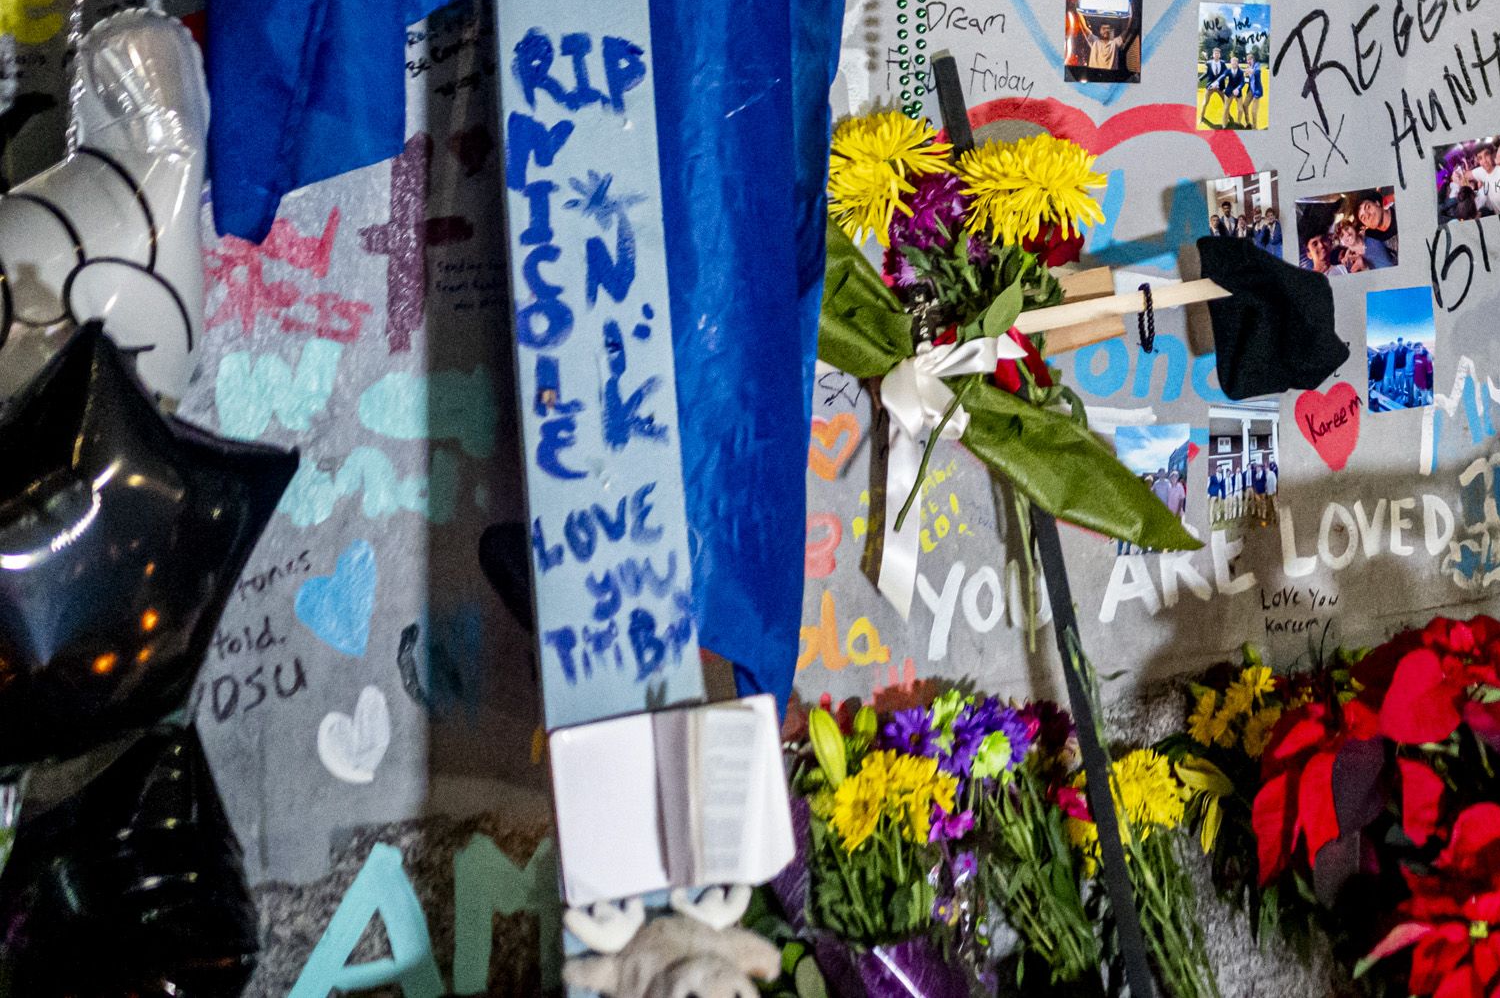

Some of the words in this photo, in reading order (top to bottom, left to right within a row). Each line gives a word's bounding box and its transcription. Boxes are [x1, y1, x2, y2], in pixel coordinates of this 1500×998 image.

[924, 0, 1006, 36] Dream
[510, 27, 647, 115] RIP
[1304, 393, 1365, 445] Kareem
[1280, 493, 1456, 579] LOVED
